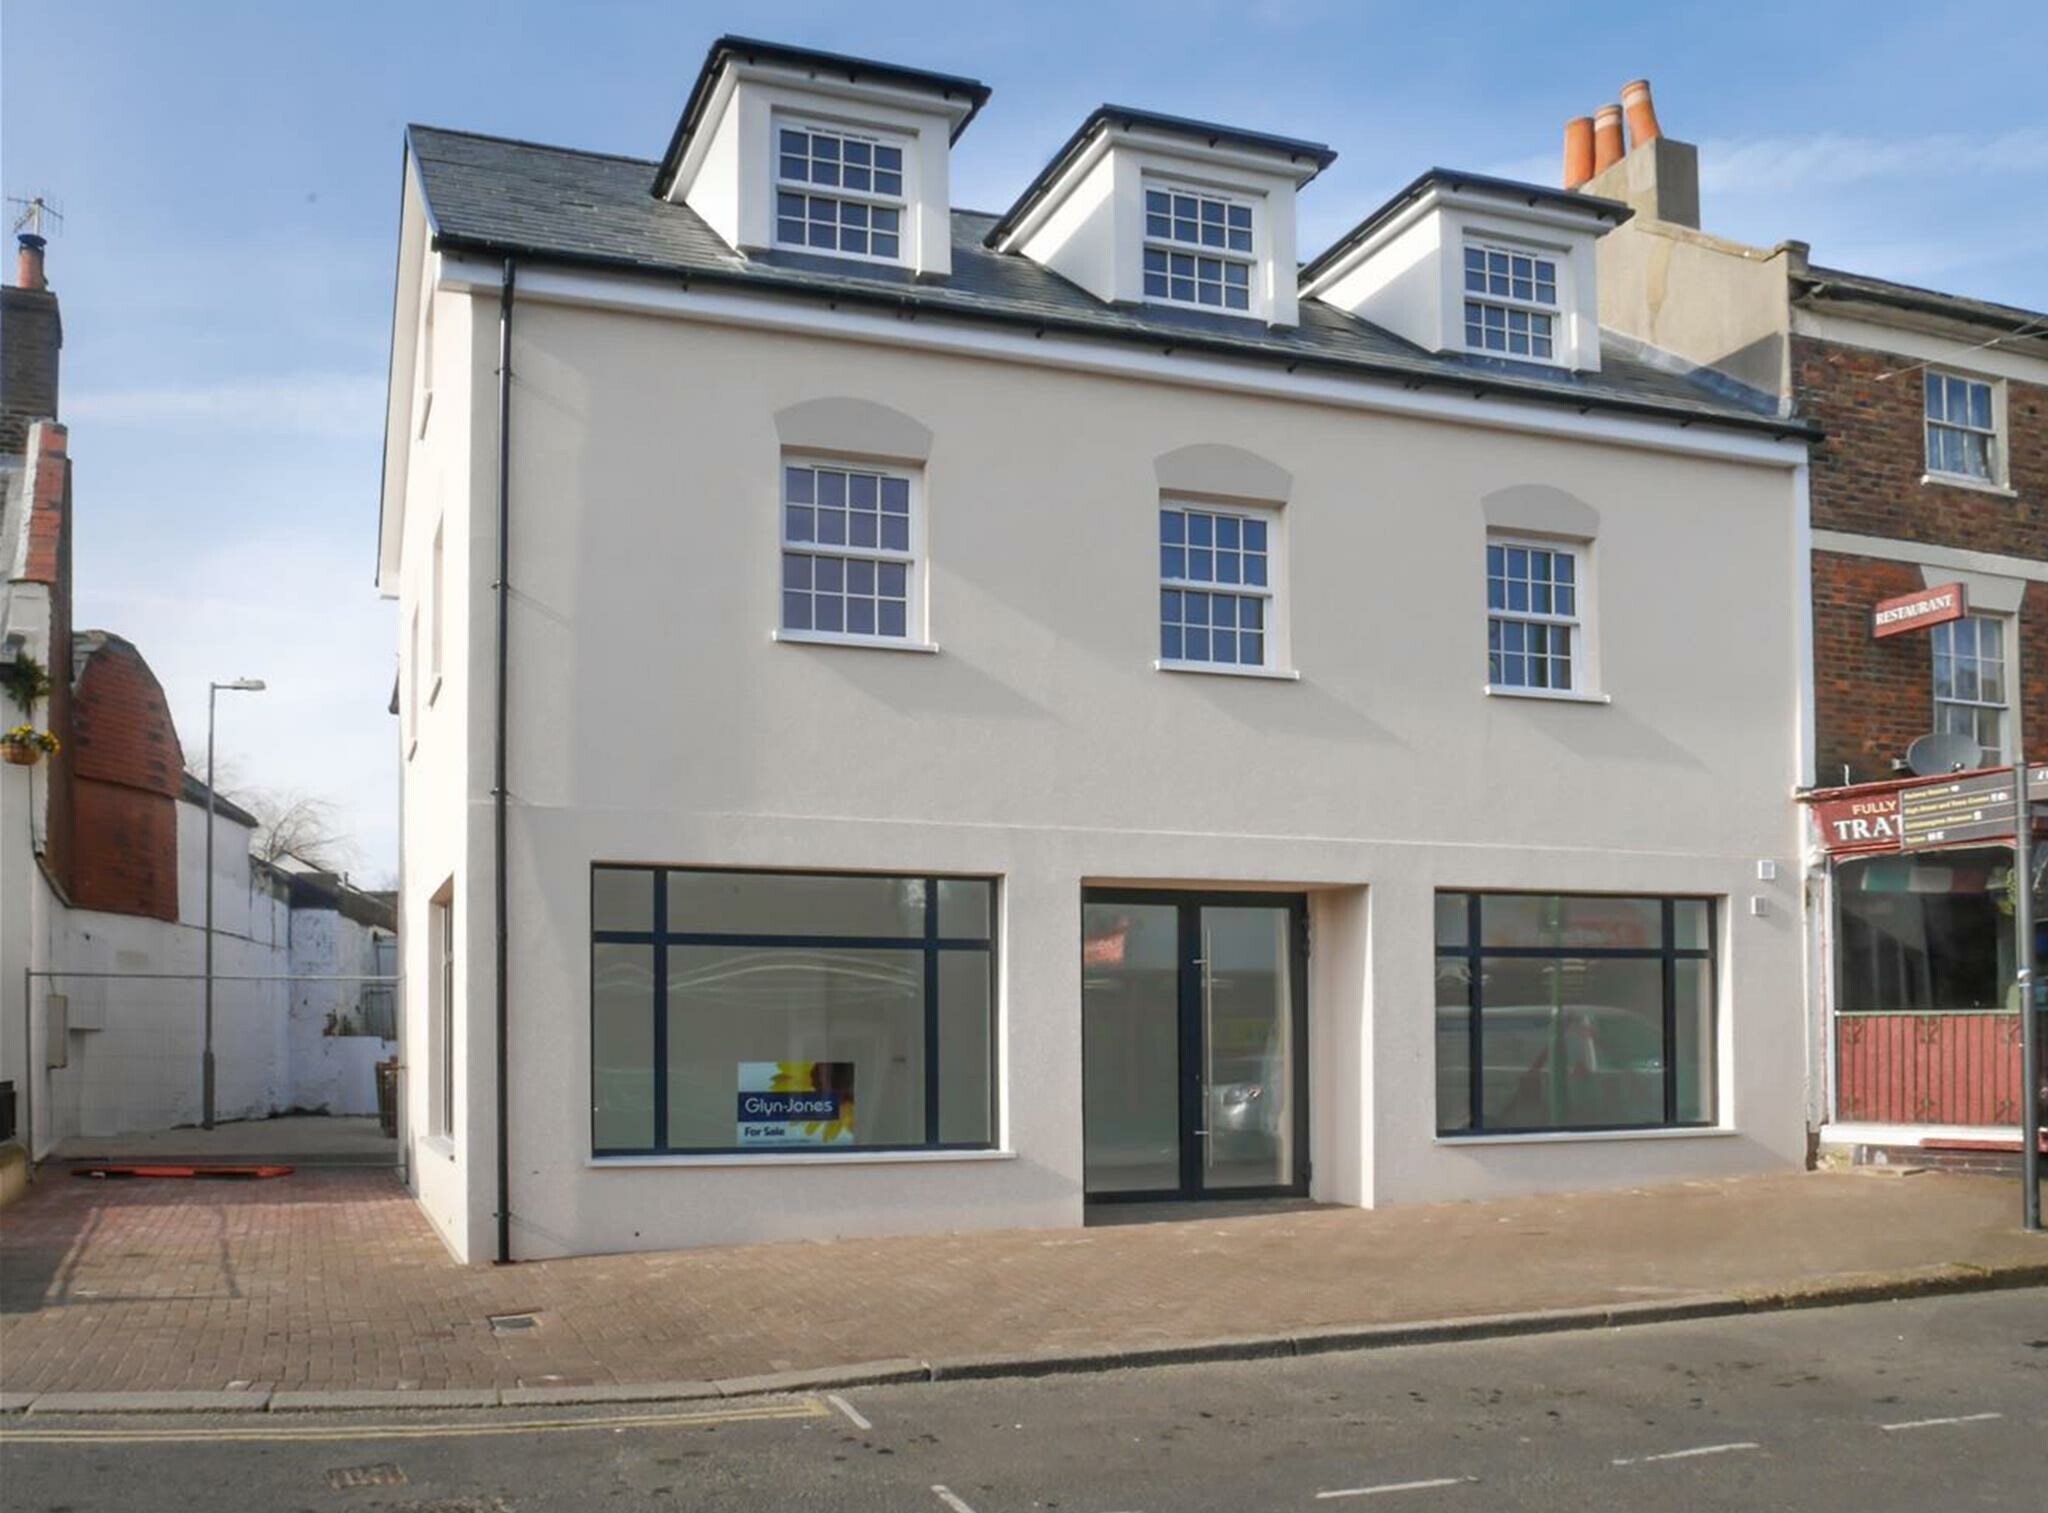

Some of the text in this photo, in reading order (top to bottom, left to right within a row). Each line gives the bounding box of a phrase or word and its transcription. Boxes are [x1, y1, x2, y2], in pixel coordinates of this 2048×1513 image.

[1876, 593, 1953, 626] RESTAURANT
[1852, 801, 1897, 815] FULLY
[744, 1126, 785, 1137] For Sale
